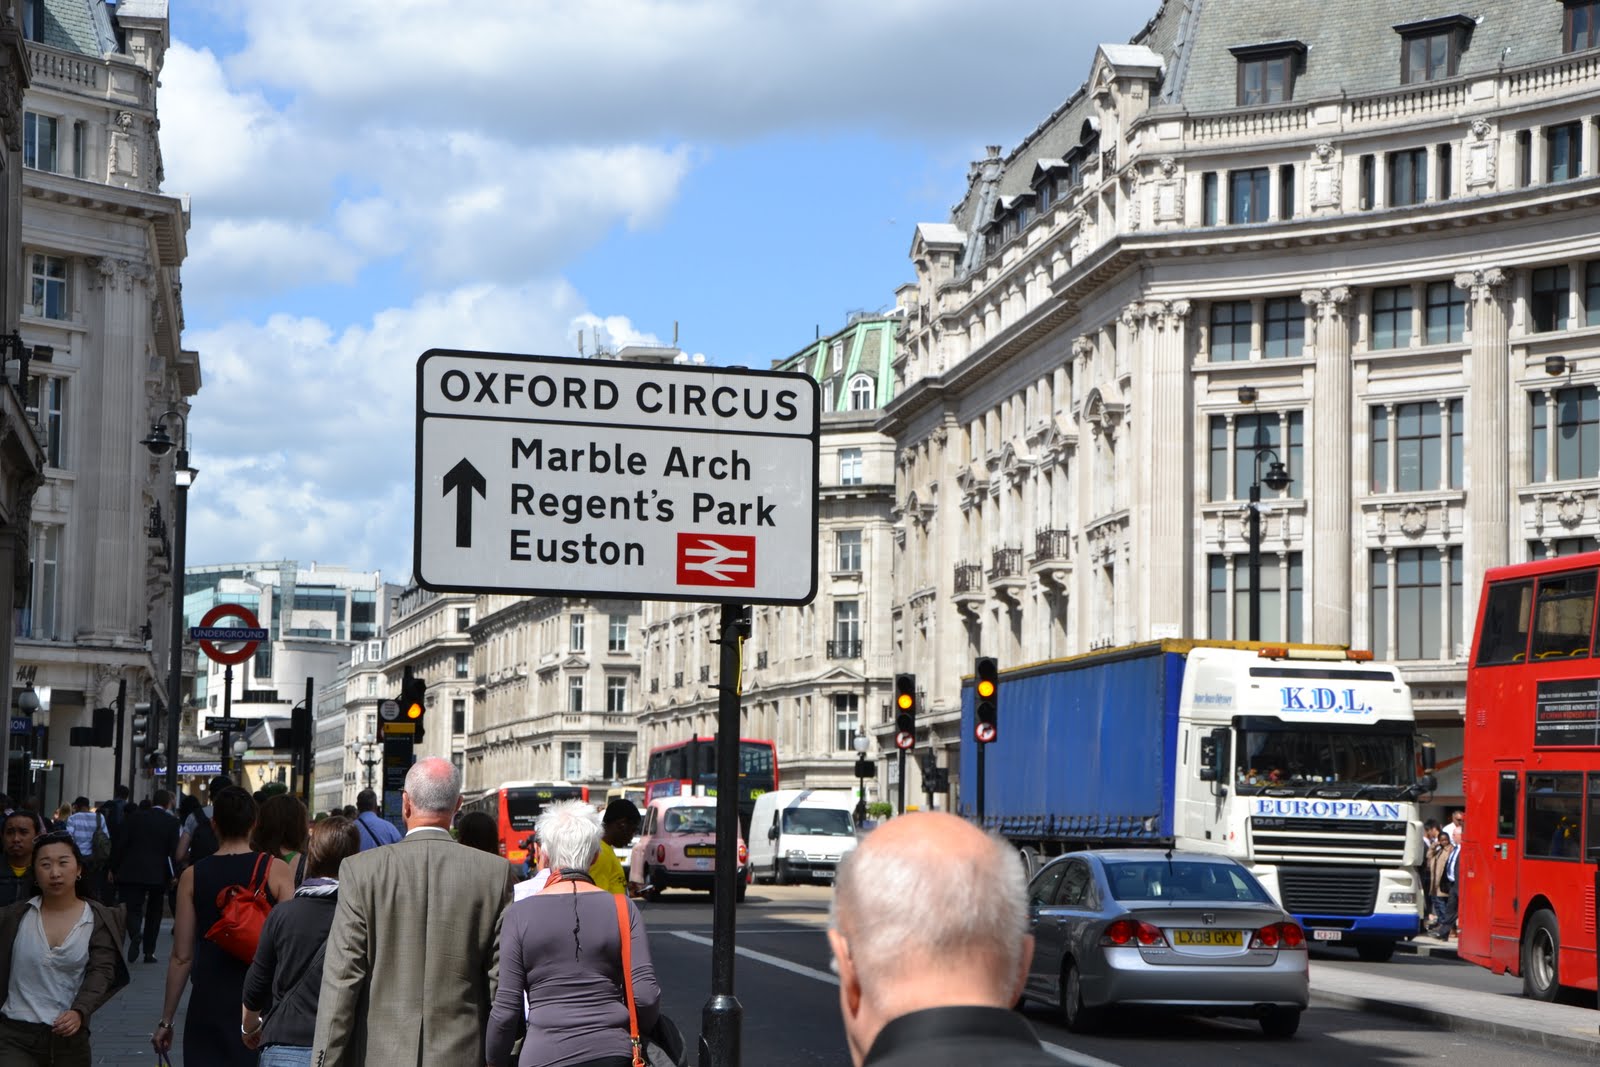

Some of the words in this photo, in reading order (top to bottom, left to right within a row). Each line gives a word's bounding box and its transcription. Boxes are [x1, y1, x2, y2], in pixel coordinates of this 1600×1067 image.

[441, 370, 618, 410] OXFORD
[636, 382, 797, 421] CIRCUS
[512, 438, 646, 475] Marble
[664, 447, 750, 480] Arch
[512, 484, 674, 524] Regent's
[693, 493, 776, 526] Park
[511, 530, 644, 565] Euston
[193, 629, 265, 639] UNDERGROUND
[1281, 687, 1373, 714] K.D.L.
[1254, 818, 1285, 826] DAF
[1257, 800, 1401, 819] EUROPEAN
[1214, 931, 1238, 944] GKY
